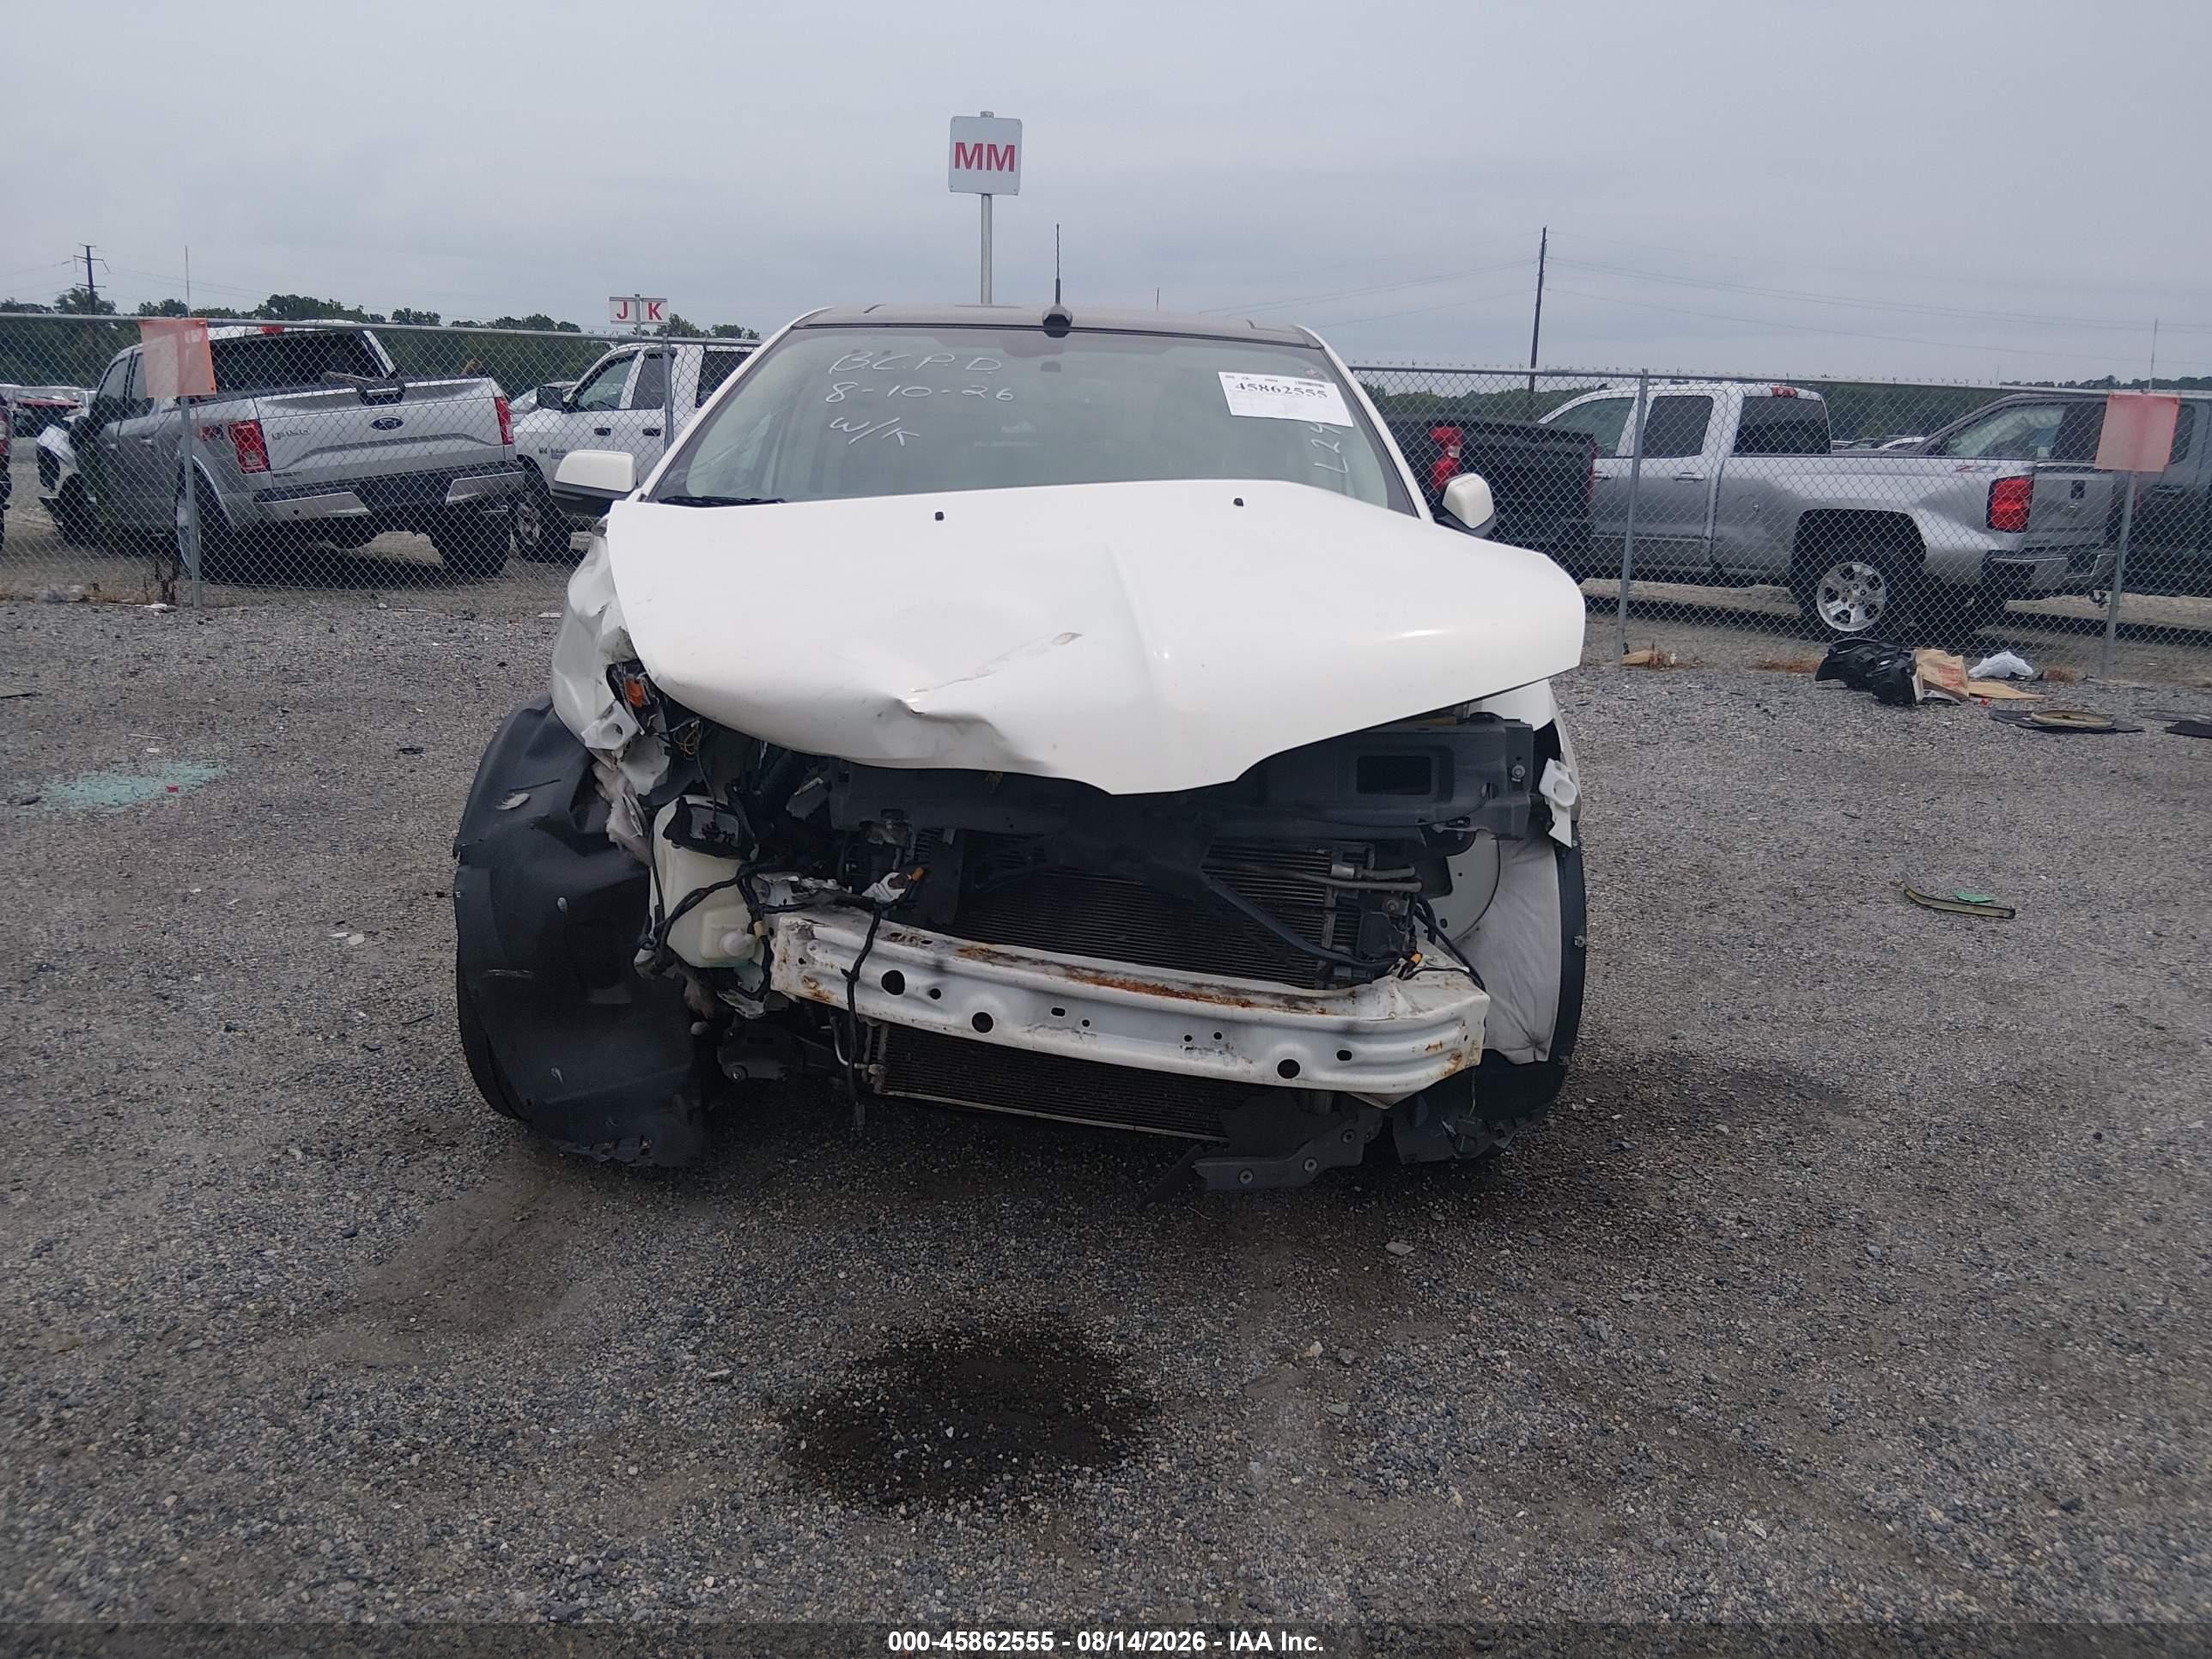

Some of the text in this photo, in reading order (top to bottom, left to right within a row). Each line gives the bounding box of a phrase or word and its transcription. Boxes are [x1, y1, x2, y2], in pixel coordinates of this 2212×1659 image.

[954, 142, 1015, 172] MM
[617, 301, 628, 319] J
[647, 301, 663, 320] K
[825, 382, 1014, 402] 8-10-26
[1235, 383, 1328, 399] 45862555
